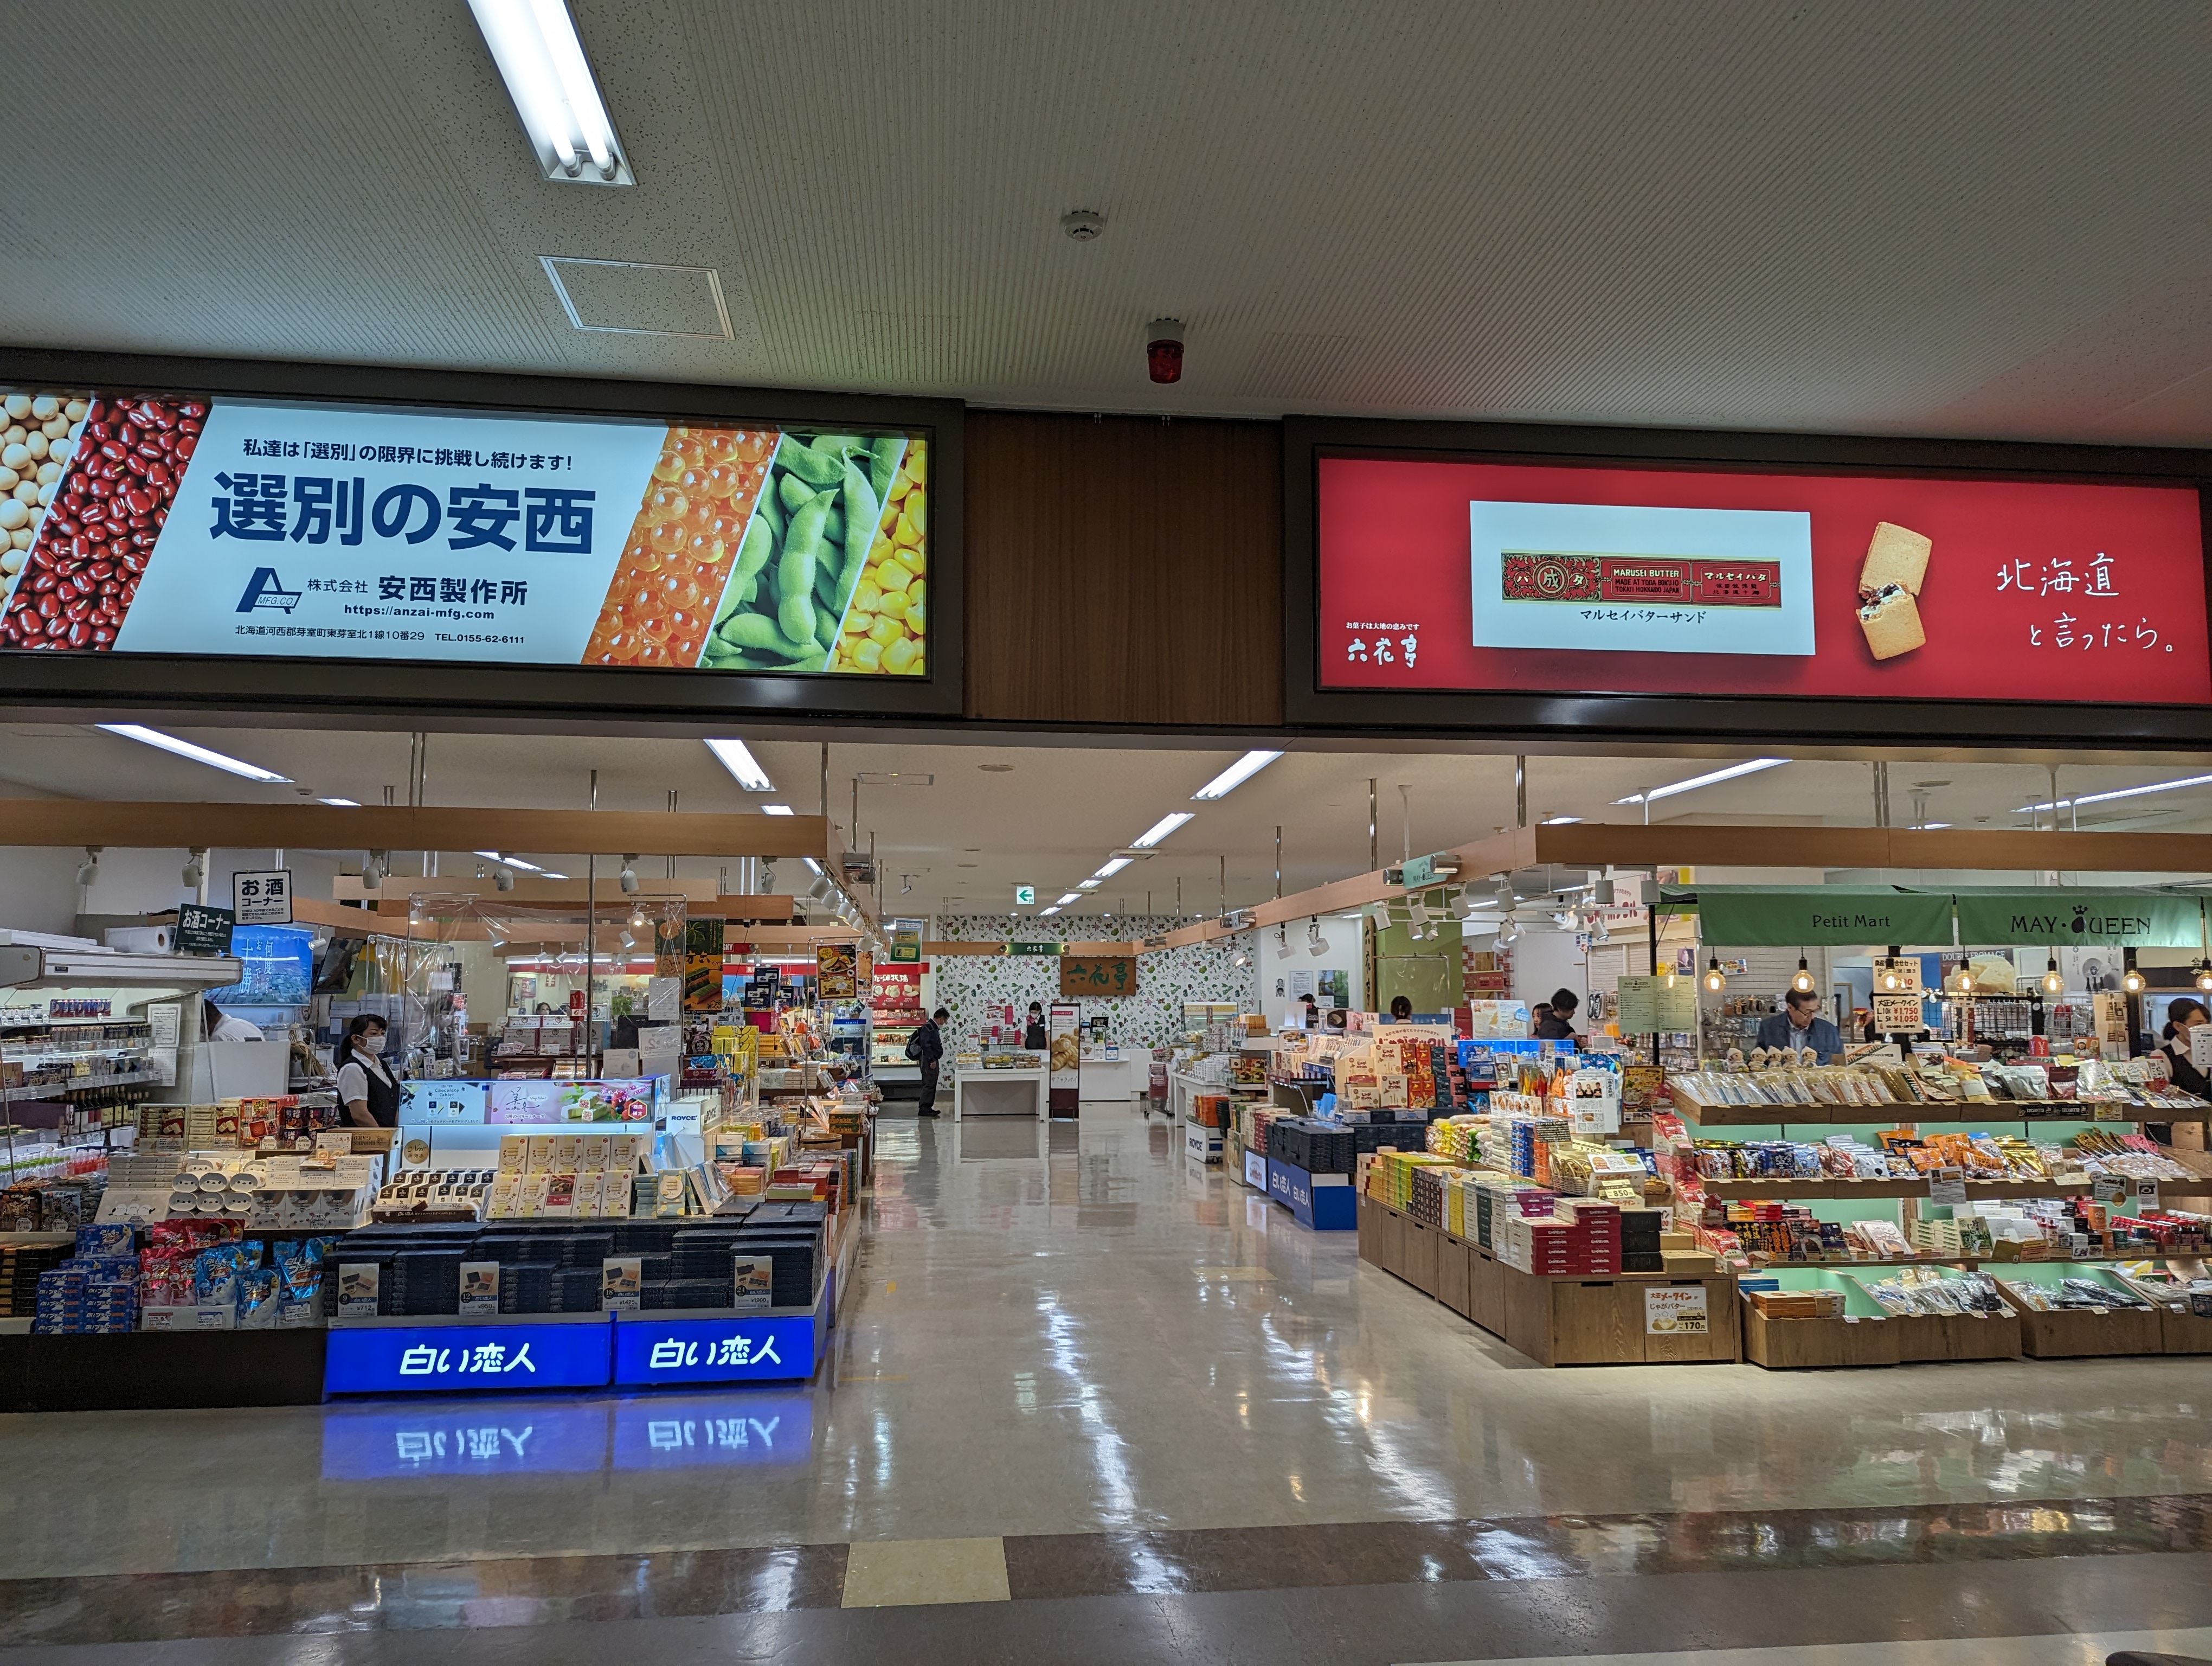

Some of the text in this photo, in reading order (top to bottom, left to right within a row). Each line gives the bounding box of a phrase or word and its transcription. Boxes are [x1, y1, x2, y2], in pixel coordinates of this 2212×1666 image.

[210, 470, 596, 554] 選別の安西
[1542, 569, 1561, 588] 成
[1613, 569, 1680, 578] MARUSEI BUTTER
[1997, 553, 2119, 597] 北海道
[307, 575, 529, 606] 株式会社 安西製作所
[344, 604, 494, 620] https://anzai-mfg.com
[1580, 609, 1707, 624] マルセイバターサンド
[1346, 622, 1419, 631] お菓子は大地の恵みです
[2031, 612, 2172, 652] と言ったら。
[435, 633, 525, 644] TEL.0155-62-6111
[1348, 633, 1417, 668] 六花亭
[242, 878, 284, 896] お酒
[241, 896, 284, 907] コーナー
[183, 909, 230, 931] お酒コーナー
[1813, 915, 1891, 927] Petit Mart
[239, 938, 254, 994] 十勝
[1942, 953, 1969, 961] DOUBLE
[1066, 961, 1128, 991] 六花亭
[407, 1143, 427, 1152] New
[1684, 1322, 1705, 1330] 170円
[400, 1343, 536, 1375] 白い恋人
[650, 1335, 781, 1369] 白い恋人
